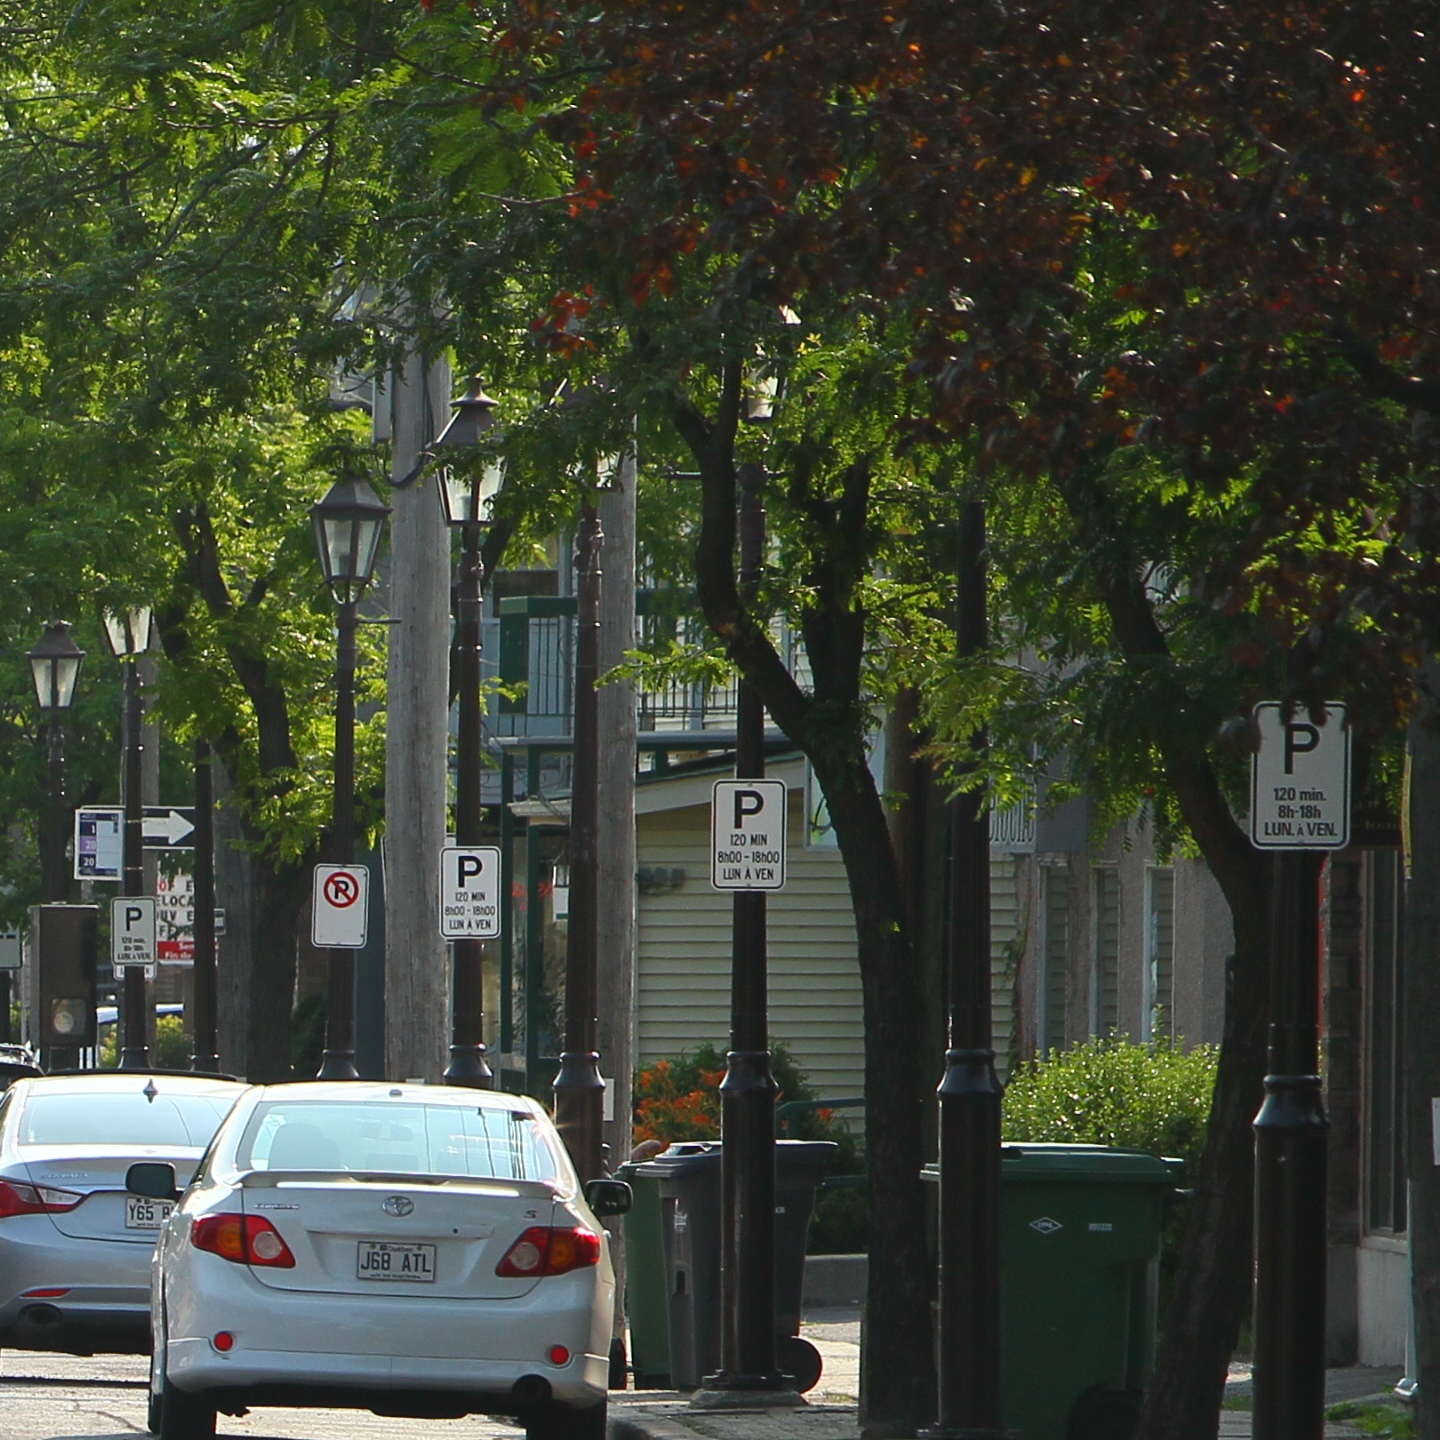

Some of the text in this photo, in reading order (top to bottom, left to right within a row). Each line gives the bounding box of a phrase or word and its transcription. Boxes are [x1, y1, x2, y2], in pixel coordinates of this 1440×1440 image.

[1284, 723, 1320, 774] P
[1273, 788, 1327, 801] 120 min.
[734, 790, 765, 829] P
[1278, 805, 1322, 818] 8h-18h
[1264, 822, 1295, 836] LUN.
[1307, 822, 1338, 836] VEN.
[730, 834, 768, 846] 120 MIN
[718, 851, 742, 863] 8h00
[752, 851, 780, 863] 18h00
[457, 855, 483, 888] P
[723, 868, 741, 880] LUN
[755, 868, 774, 880] VEN
[455, 891, 486, 902] 120 MIN
[125, 907, 143, 931] P
[449, 920, 464, 930] LUN
[476, 920, 491, 930] VEN
[129, 1205, 154, 1220] Y65
[361, 1251, 432, 1273] J68 ATL
